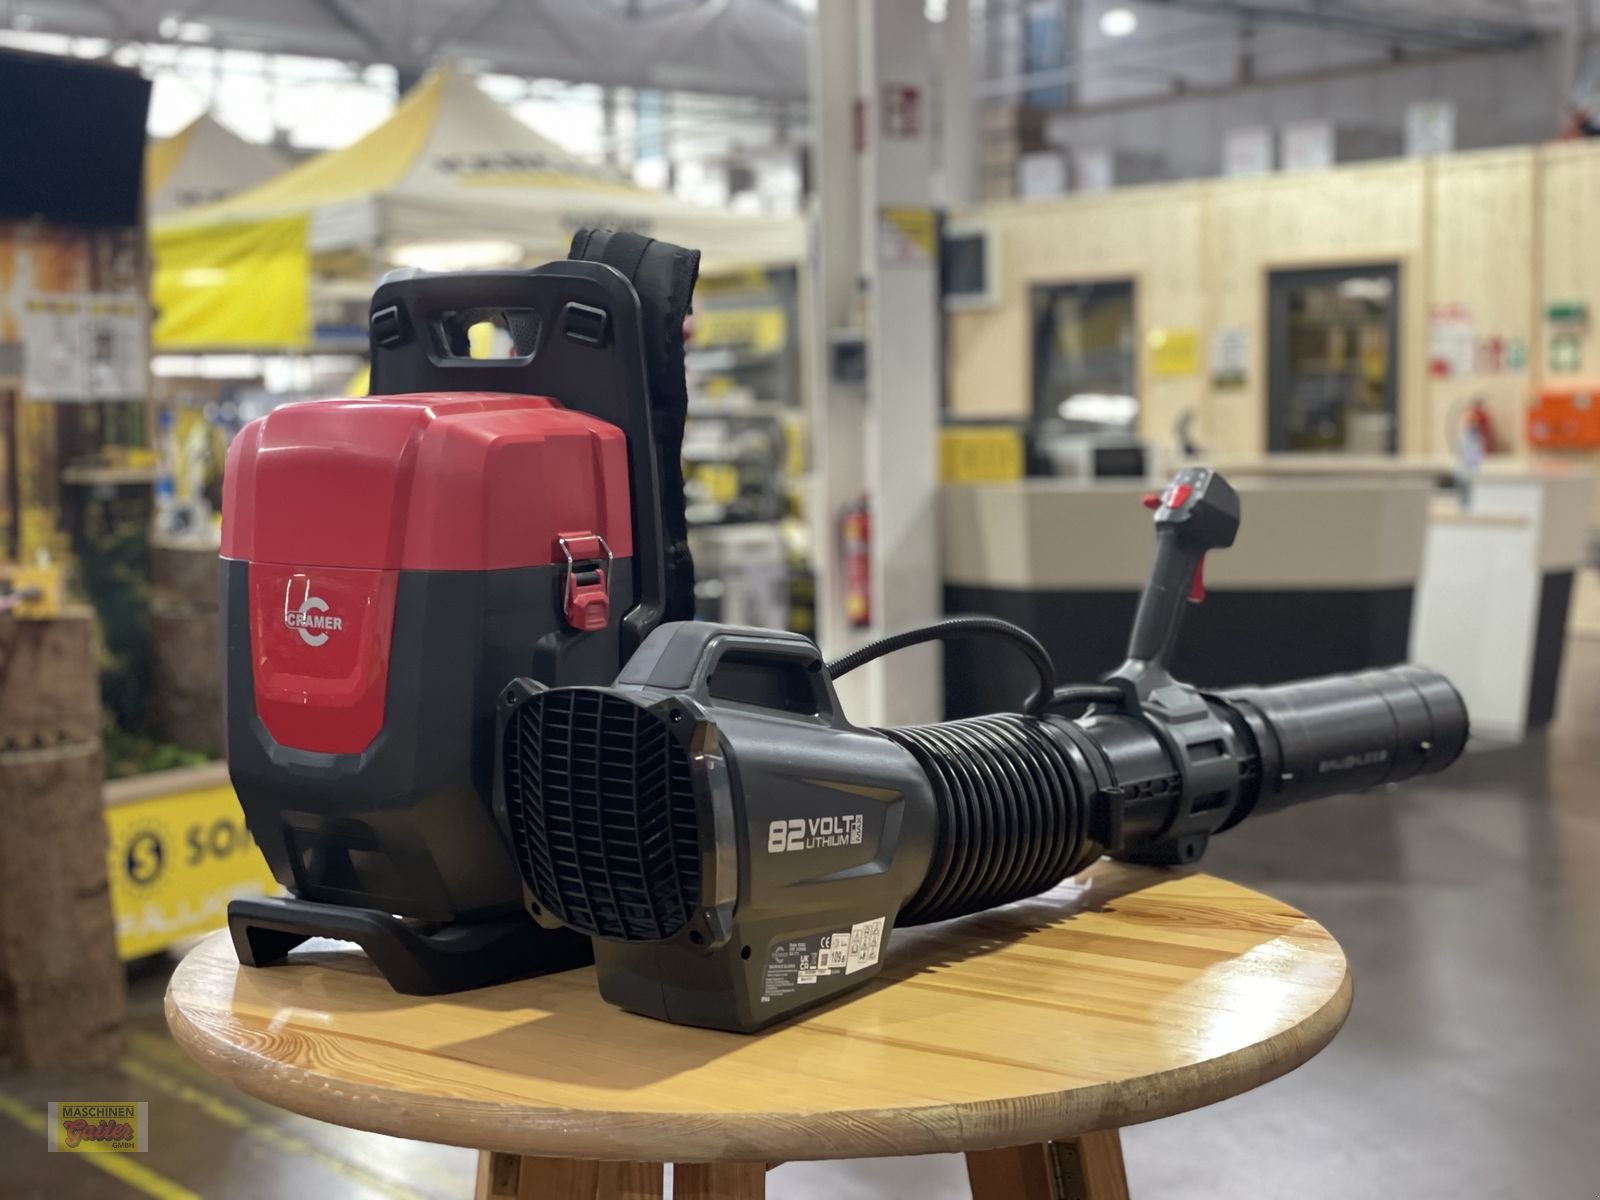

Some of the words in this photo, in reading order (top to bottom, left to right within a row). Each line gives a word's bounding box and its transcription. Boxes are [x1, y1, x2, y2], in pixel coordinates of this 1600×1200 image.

[287, 613, 343, 631] CRAMER
[768, 818, 806, 854] 82
[808, 814, 855, 837] VOLT
[806, 834, 850, 849] LITHIUM
